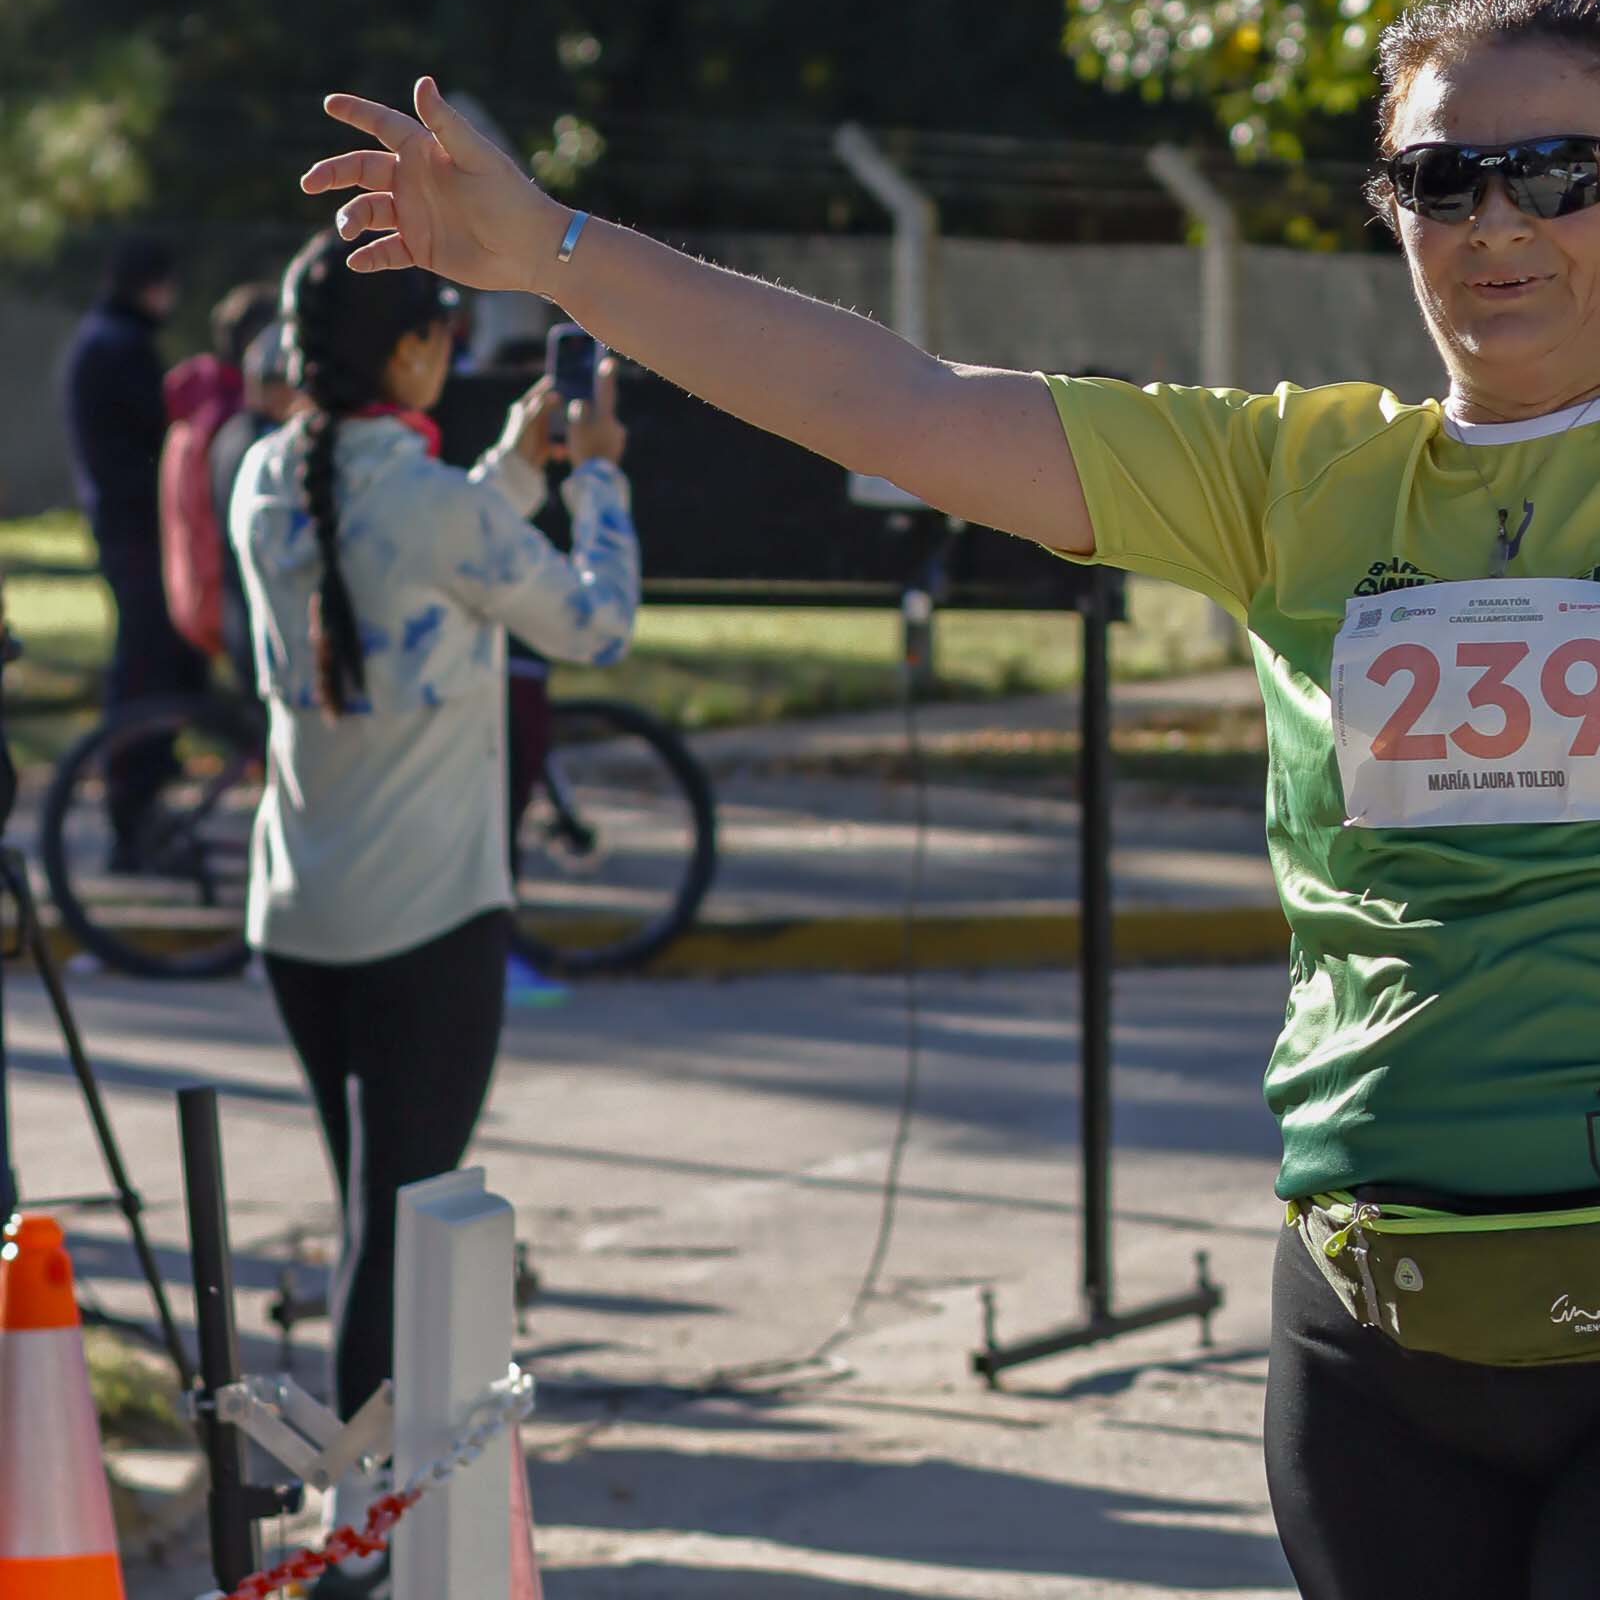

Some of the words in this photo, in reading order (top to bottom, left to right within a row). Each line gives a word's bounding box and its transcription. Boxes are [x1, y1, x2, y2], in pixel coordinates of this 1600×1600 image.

[1428, 769, 1471, 791] MARÍA
[1473, 771, 1515, 789] LAURA
[1517, 770, 1566, 788] TOLEDO
